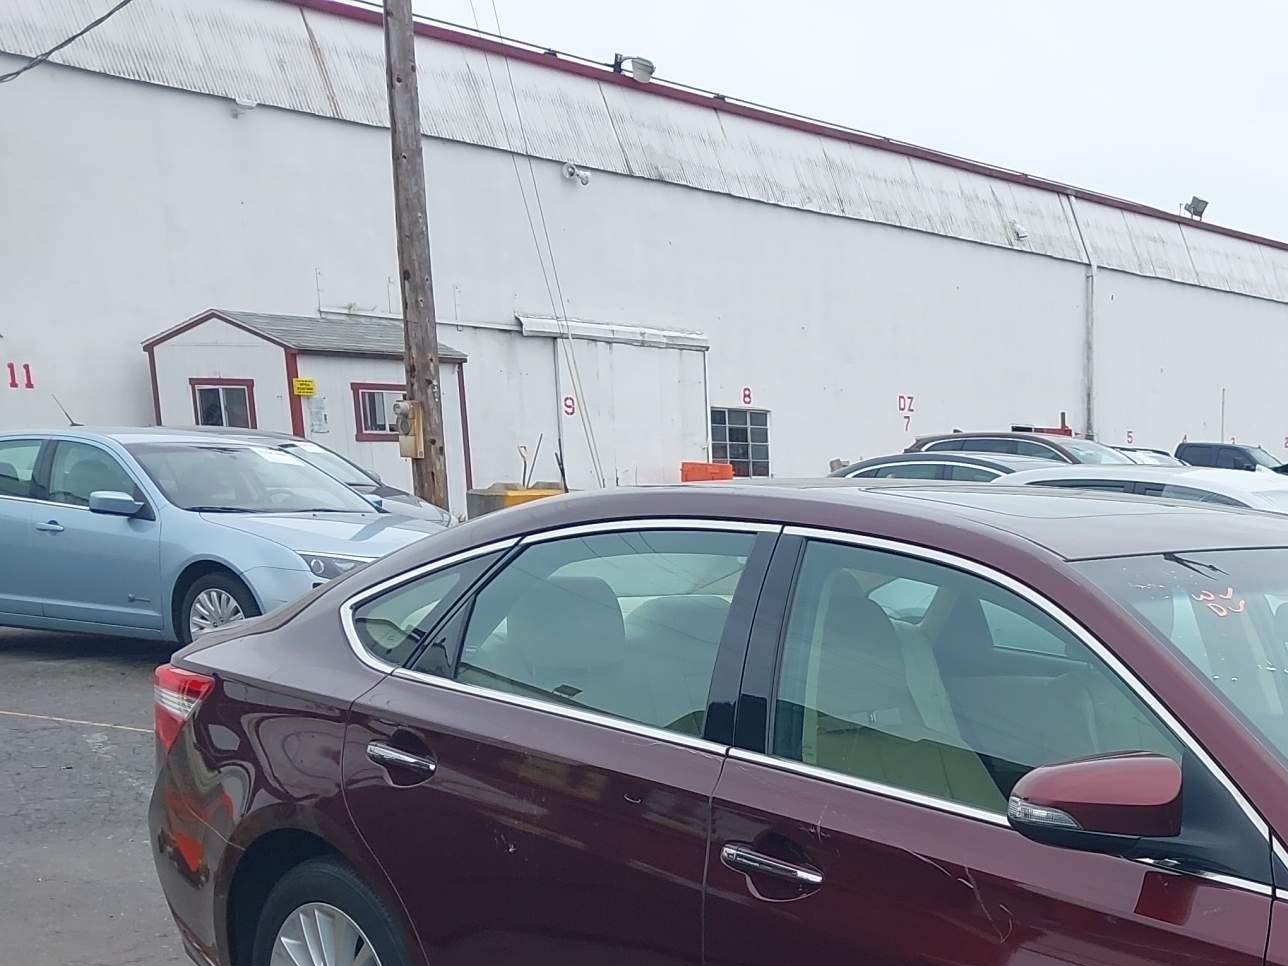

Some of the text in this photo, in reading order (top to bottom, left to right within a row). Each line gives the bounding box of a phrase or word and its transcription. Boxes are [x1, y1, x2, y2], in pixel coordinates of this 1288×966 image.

[7, 362, 34, 389] 11
[743, 387, 752, 405] 8
[563, 396, 576, 415] 9
[903, 415, 911, 432] 7
[1126, 430, 1134, 444] 5
[1284, 436, 1288, 449] 2
